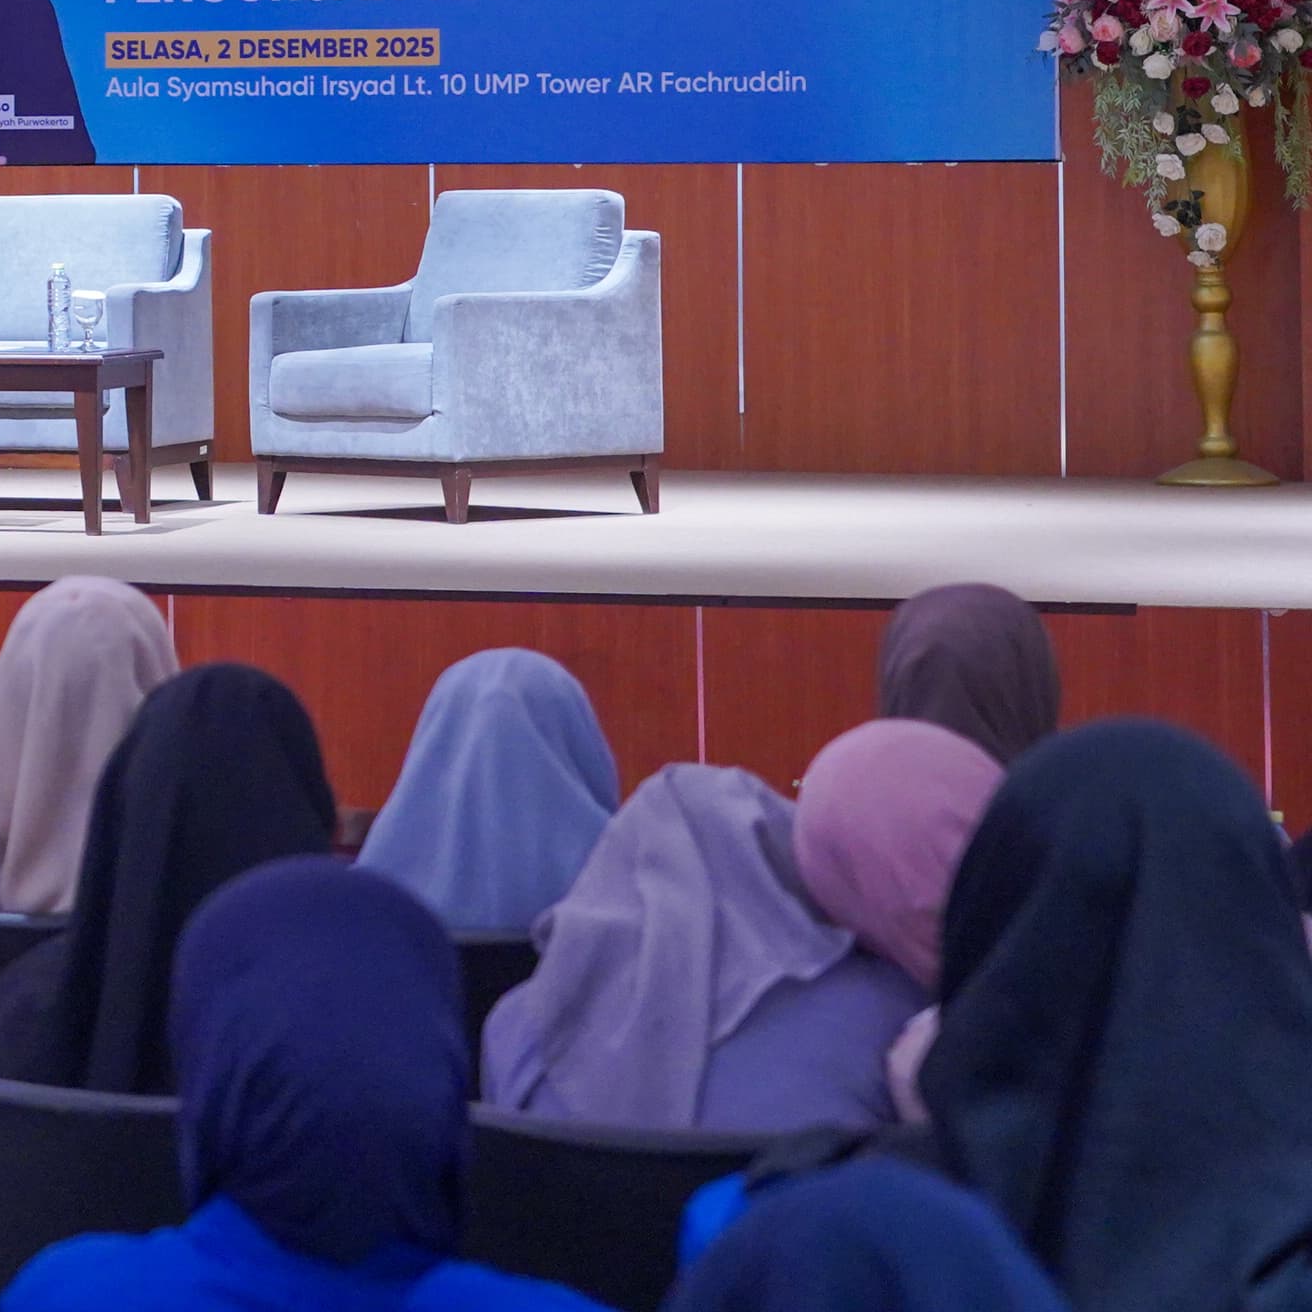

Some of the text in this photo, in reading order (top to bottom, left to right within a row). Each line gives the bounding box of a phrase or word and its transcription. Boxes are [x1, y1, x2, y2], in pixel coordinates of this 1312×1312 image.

[111, 36, 434, 62] SELASA, 2 DESEMBER 2025
[106, 70, 806, 102] Aula Syamsuhadi Irsyad Lt. 10 UMP Tower AR Fachruddin
[18, 118, 68, 126] Purwokerto
